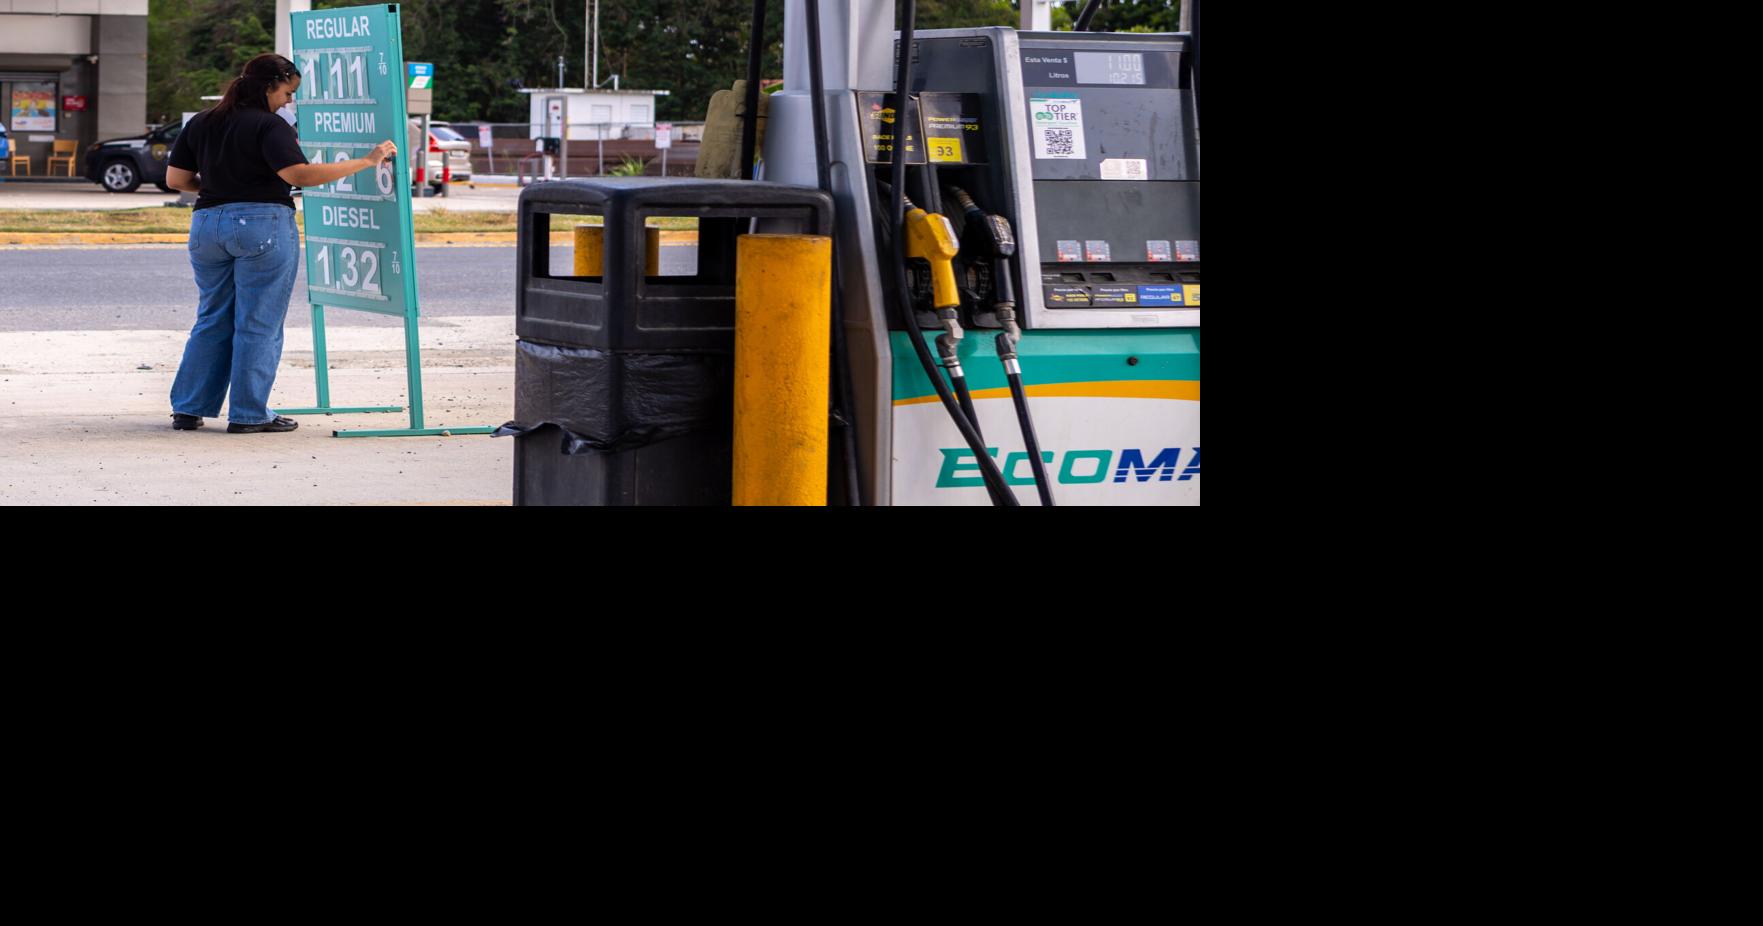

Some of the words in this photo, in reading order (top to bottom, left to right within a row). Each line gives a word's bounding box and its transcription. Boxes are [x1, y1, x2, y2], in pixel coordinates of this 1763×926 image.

[306, 16, 371, 39] REGULAR
[303, 55, 364, 99] 1.11
[379, 64, 387, 75] 10
[1045, 104, 1066, 112] TOP
[314, 112, 376, 133] PREMIUM
[322, 205, 380, 230] DIESEL
[317, 245, 379, 292] 1.32
[392, 264, 400, 274] 10
